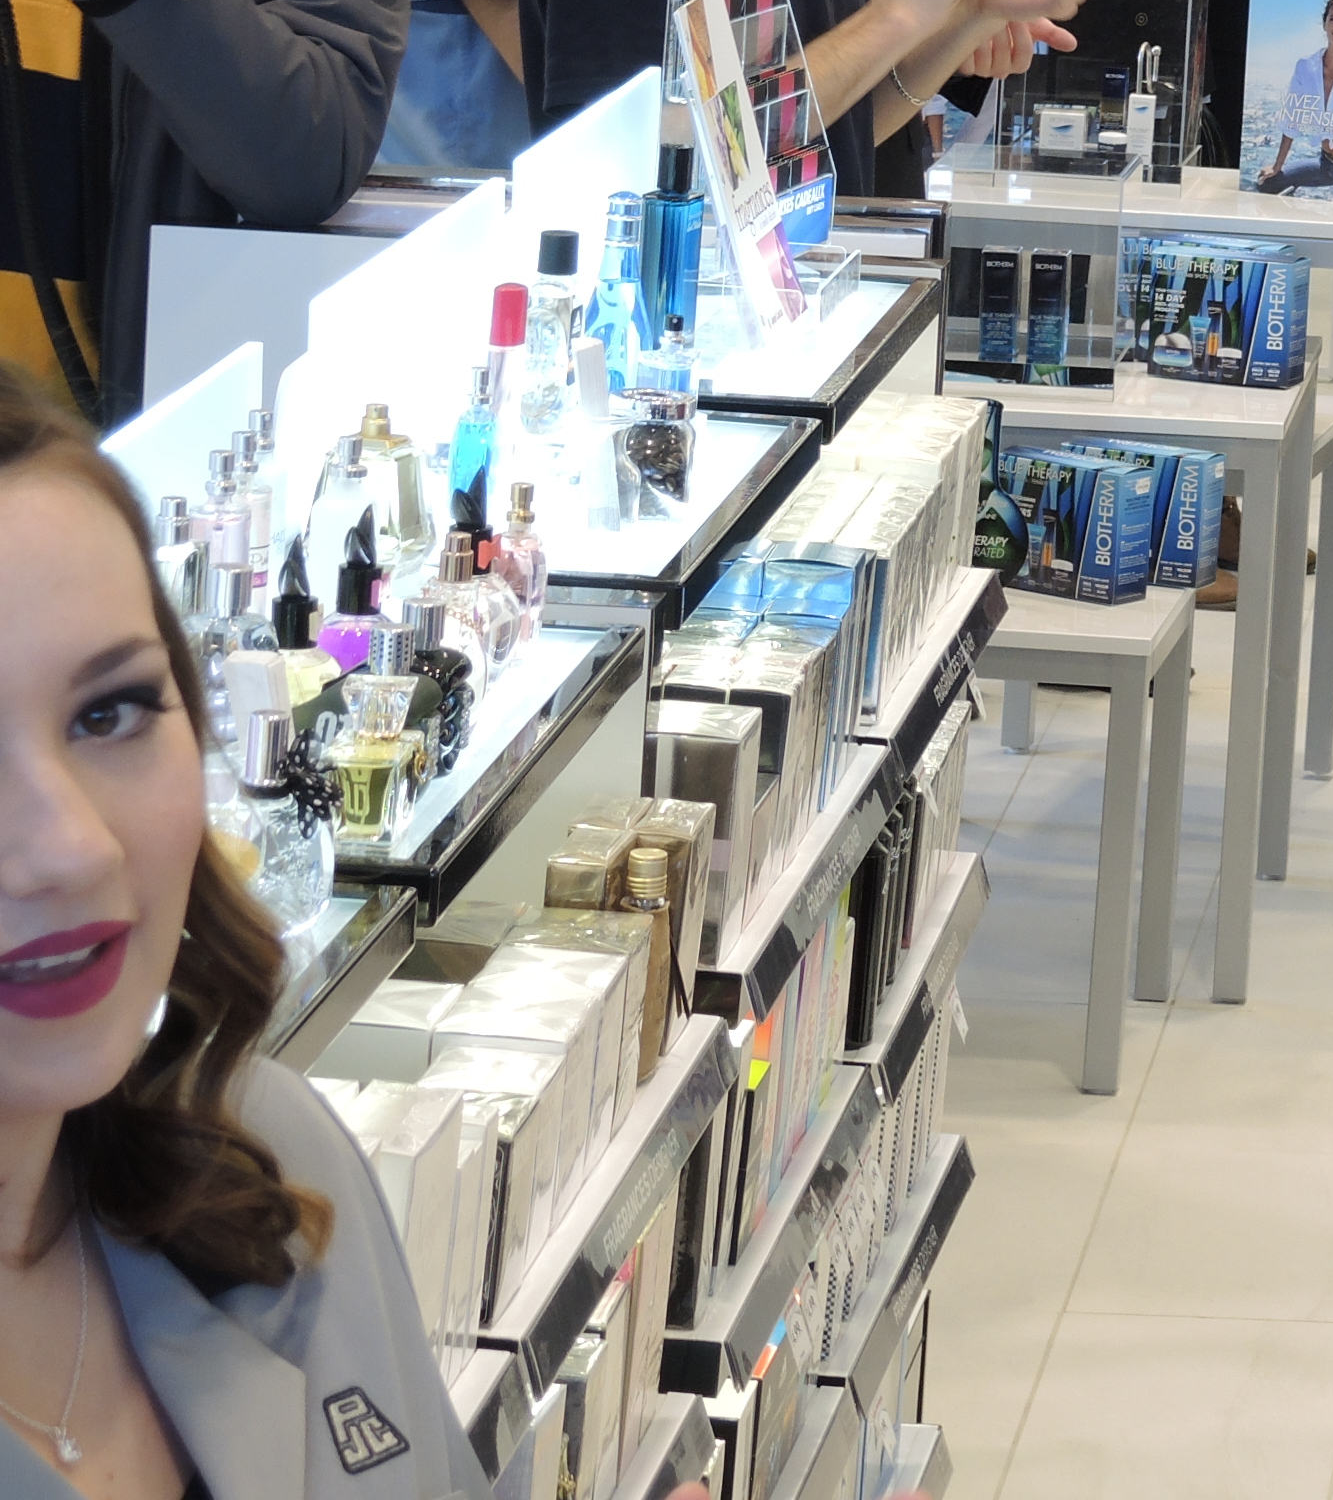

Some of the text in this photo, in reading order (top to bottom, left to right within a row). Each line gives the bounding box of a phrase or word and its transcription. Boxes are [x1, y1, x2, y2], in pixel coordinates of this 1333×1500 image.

[1281, 94, 1321, 111] VIVEZ
[732, 182, 774, 237] fragrances
[795, 183, 825, 210] CADEAUX
[1156, 258, 1240, 276] BLUE THERAPY
[1154, 293, 1185, 303] 14 DAY
[1266, 268, 1287, 351] BIOTHERM
[998, 459, 1072, 483] BLUE THERAPY
[1095, 479, 1116, 566] BIOTHERM
[1177, 465, 1199, 550] BIOTHERM
[806, 852, 843, 920] FRAGRANCES
[603, 1127, 682, 1263] FRAGRANCES DESIGNER
